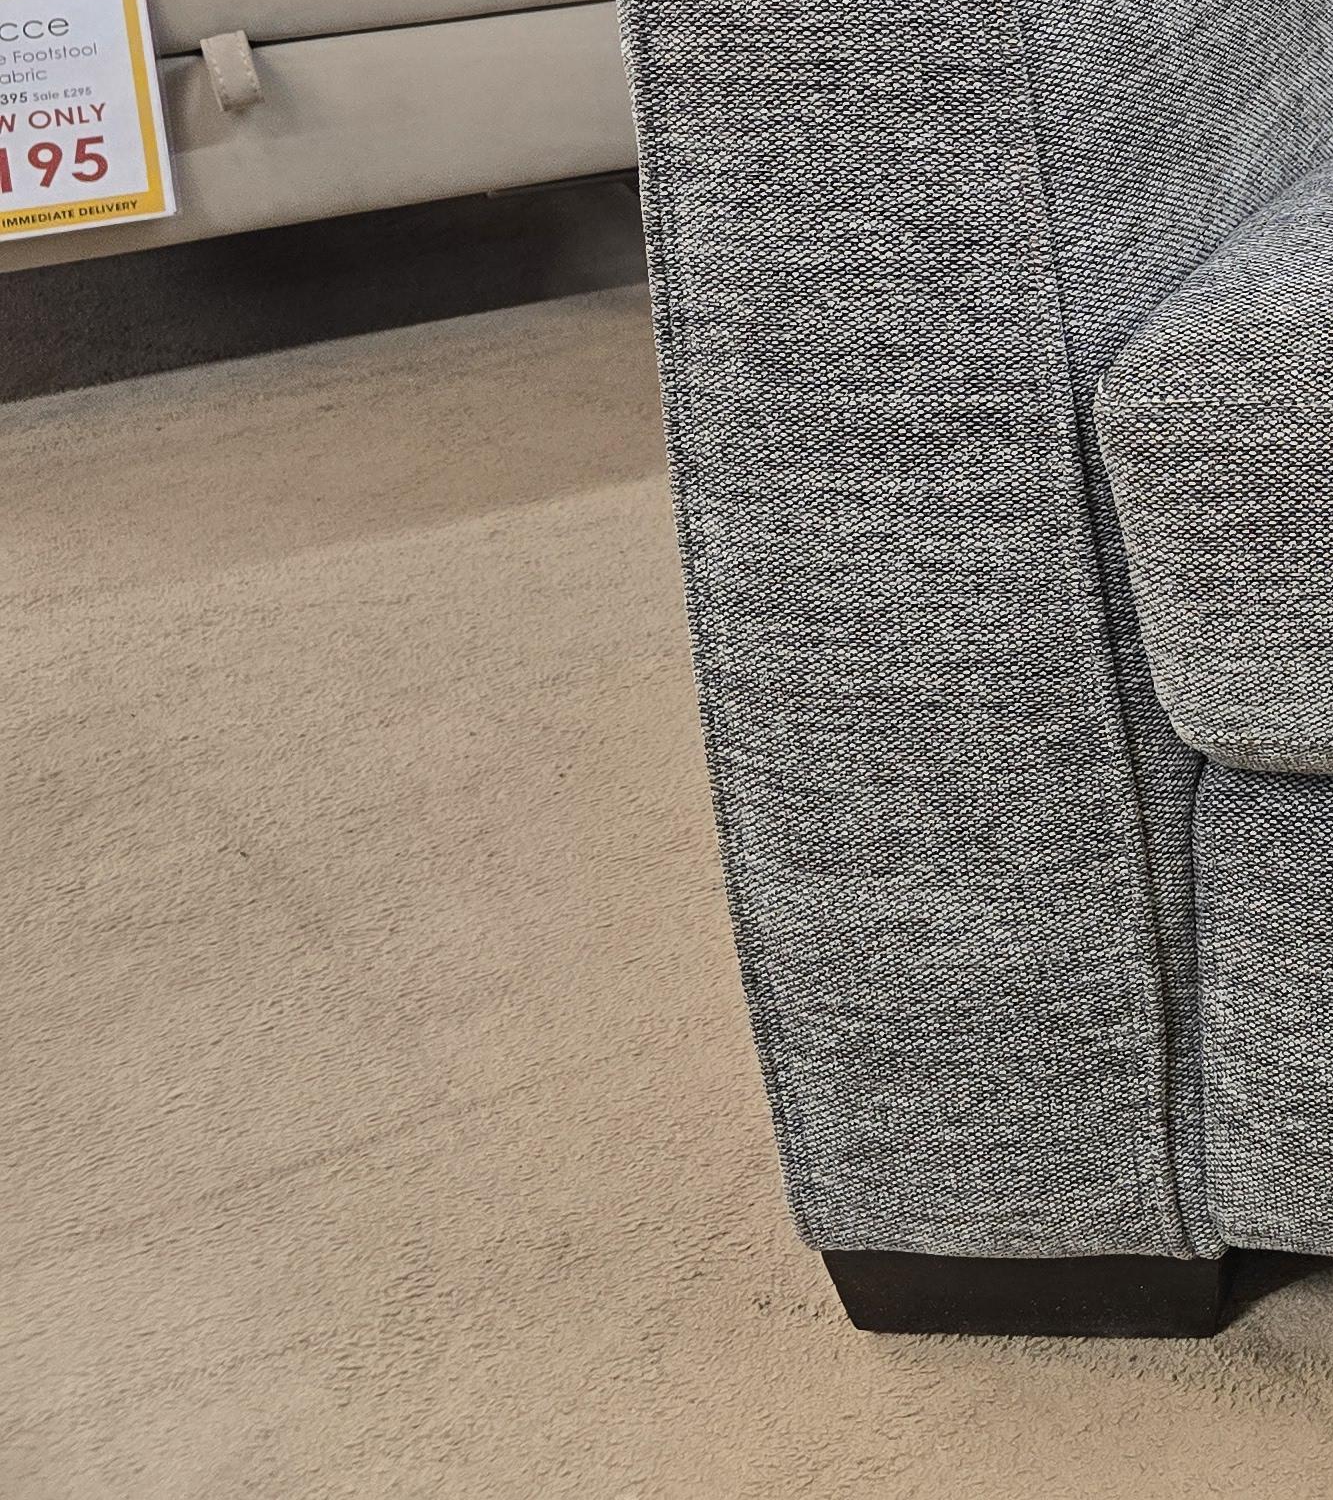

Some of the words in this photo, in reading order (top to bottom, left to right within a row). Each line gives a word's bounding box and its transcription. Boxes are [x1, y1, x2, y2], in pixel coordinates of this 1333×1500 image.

[13, 42, 97, 64] Footstool
[33, 91, 60, 102] Sale
[63, 87, 92, 99] £295
[28, 102, 106, 129] ONLY
[2, 209, 75, 228] IMMEDIATE
[80, 200, 138, 216] DELIVERY
